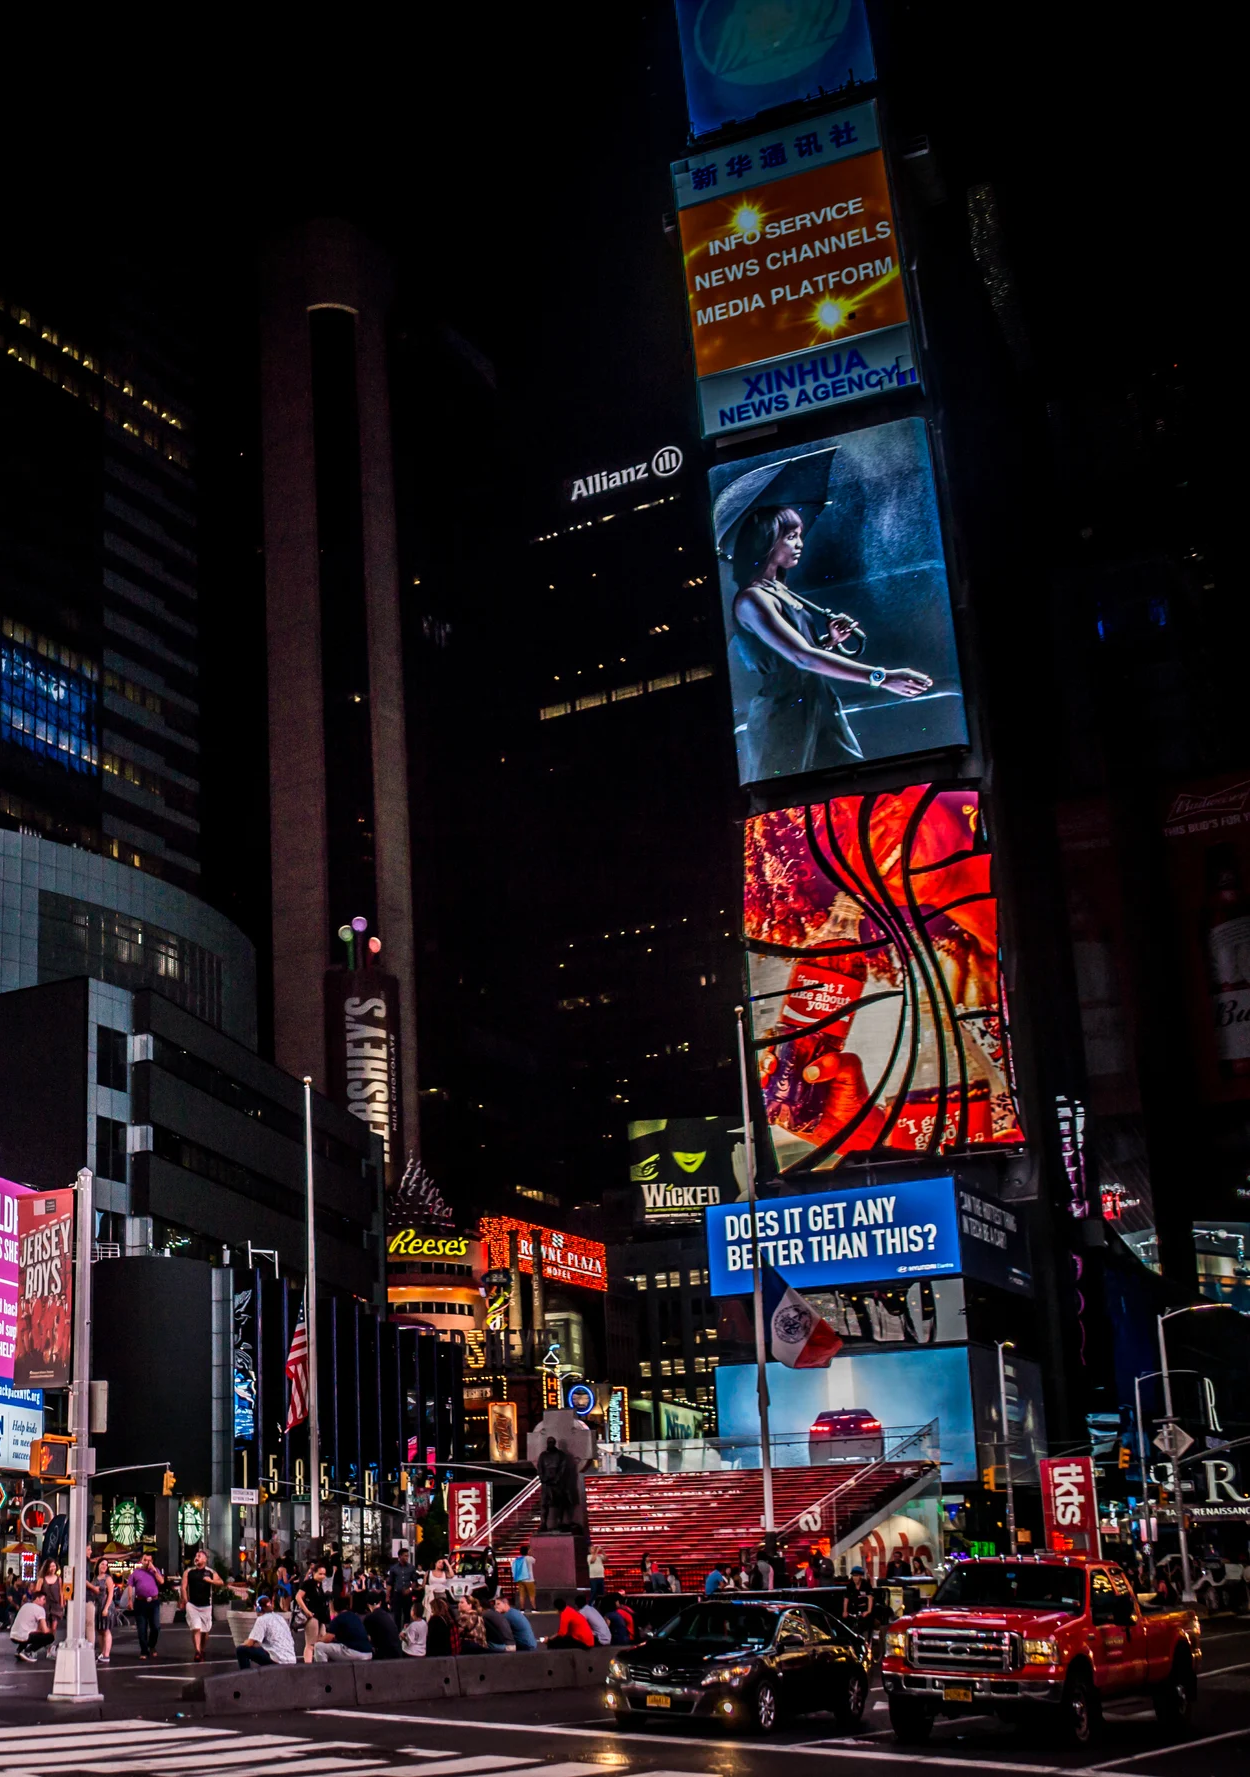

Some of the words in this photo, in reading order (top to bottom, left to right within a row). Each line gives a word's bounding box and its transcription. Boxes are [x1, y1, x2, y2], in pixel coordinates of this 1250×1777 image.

[690, 122, 859, 191] 新华通讯社
[708, 228, 761, 257] INFO
[764, 197, 865, 240] SERVICE
[694, 257, 760, 292] NEWS
[766, 220, 891, 272] CHANNELS
[696, 293, 765, 327] MEDIA
[770, 256, 893, 306] PLATFORM
[719, 393, 789, 427] NEWS
[795, 364, 898, 409] AGENCY
[742, 348, 868, 400] XINHUA
[570, 462, 649, 502] Allianz
[815, 992, 851, 1005] about
[344, 996, 391, 1164] RSHEY'S
[725, 1209, 779, 1241] DOES
[784, 1208, 802, 1235] IT
[808, 1203, 847, 1232] GET
[851, 1196, 896, 1228] ANY
[19, 1218, 72, 1268] JERSEY
[388, 1228, 470, 1256] Reese's
[567, 1252, 601, 1273] PLAZA
[809, 1228, 868, 1262] THAN
[871, 1224, 937, 1256] THIS?
[25, 1257, 62, 1300] BOYS
[546, 1267, 571, 1280] HOTEL
[12, 1420, 25, 1434] Help
[25, 1422, 38, 1434] kids
[12, 1436, 19, 1446] in
[12, 1452, 30, 1460] succee
[1052, 1463, 1085, 1526] tkts
[1202, 1460, 1250, 1502] R
[458, 1487, 481, 1540] tkts
